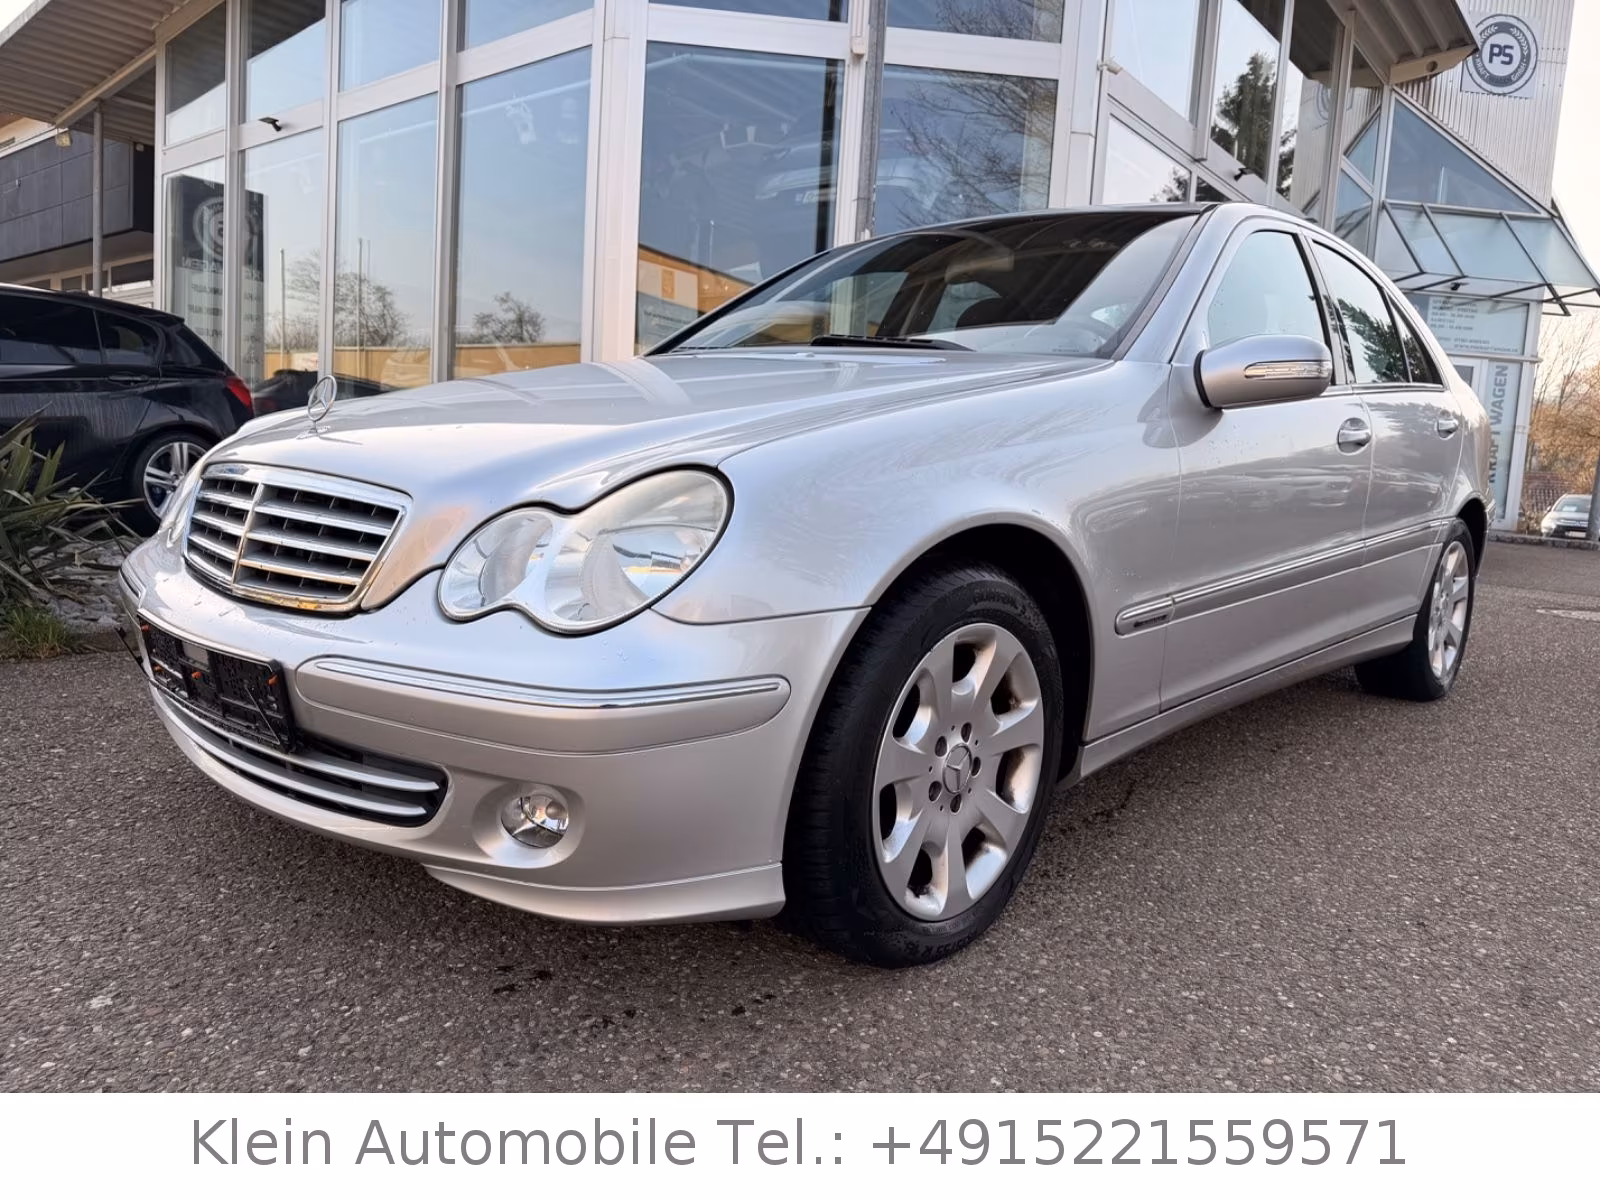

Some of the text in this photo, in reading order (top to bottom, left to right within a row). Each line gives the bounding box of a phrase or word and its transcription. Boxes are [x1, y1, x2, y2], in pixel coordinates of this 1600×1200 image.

[1488, 43, 1514, 65] PS
[1475, 58, 1489, 78] KRAFT
[1510, 62, 1526, 80] GmbH
